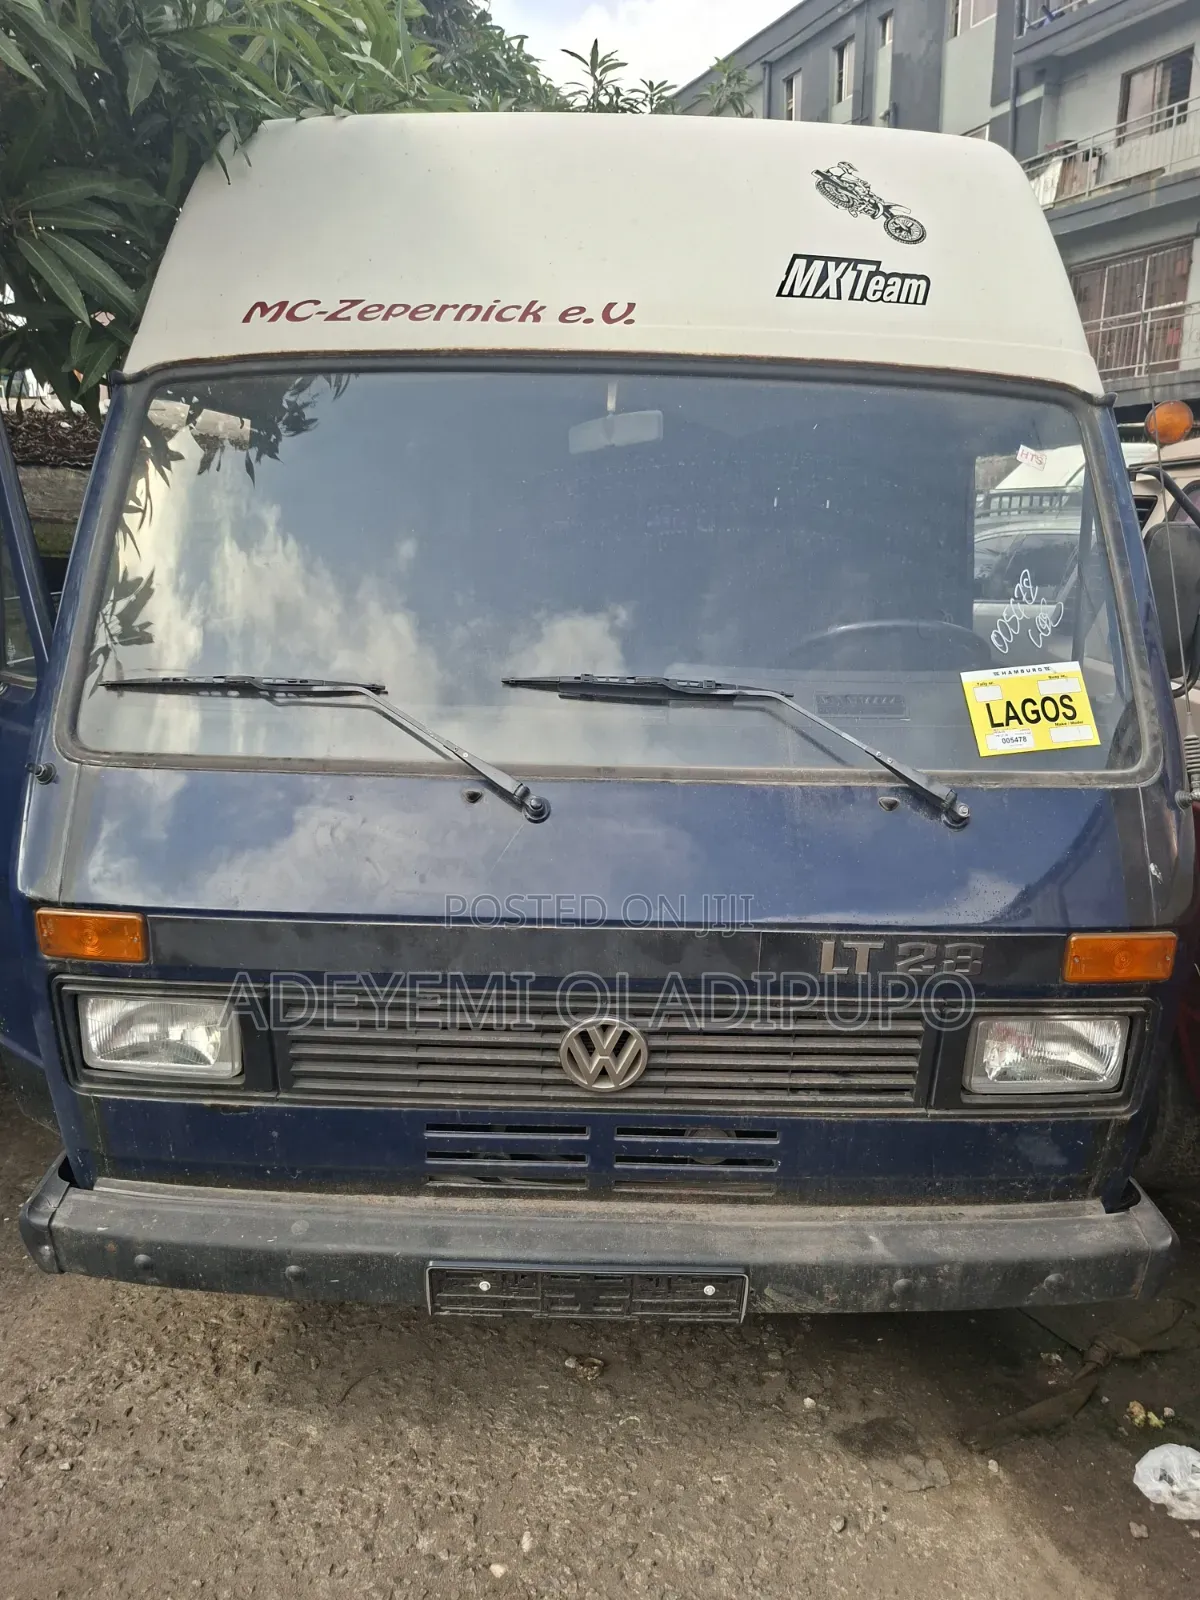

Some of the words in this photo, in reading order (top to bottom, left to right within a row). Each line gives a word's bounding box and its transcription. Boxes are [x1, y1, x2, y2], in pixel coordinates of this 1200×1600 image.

[241, 299, 547, 324] MC-Zepernick
[1020, 449, 1044, 466] HTS
[985, 694, 1077, 728] LAGOS
[1001, 735, 1028, 744] 005478
[820, 940, 885, 975] LT
[896, 942, 985, 976] 28
[559, 1017, 649, 1093] VW
